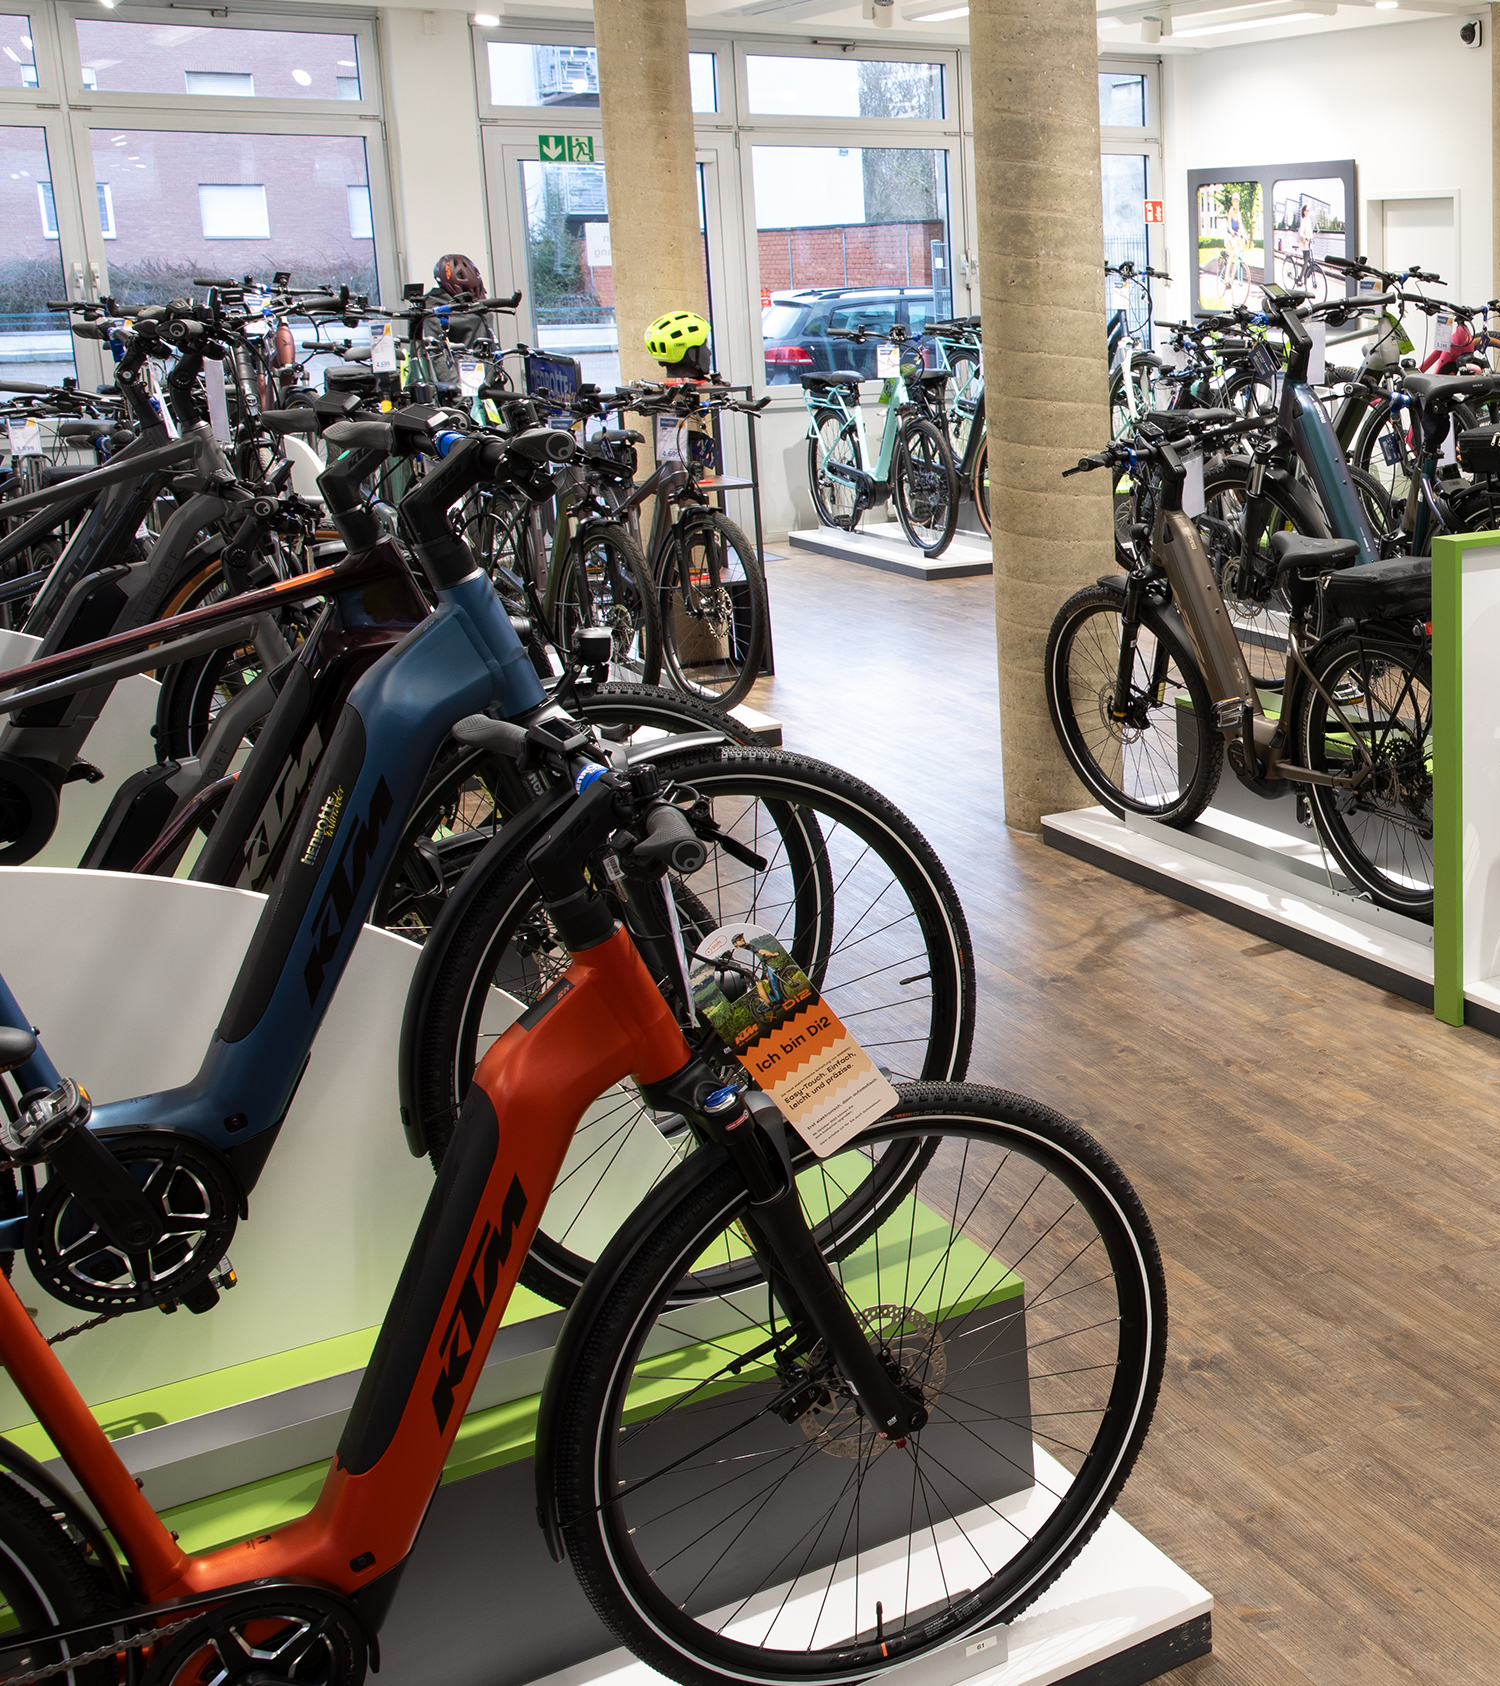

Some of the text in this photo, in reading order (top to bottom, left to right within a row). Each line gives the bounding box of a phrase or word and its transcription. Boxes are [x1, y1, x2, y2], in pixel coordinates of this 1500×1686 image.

[375, 360, 390, 368] 4.699
[16, 444, 34, 452] 3.899
[1184, 526, 1197, 550] macina
[134, 551, 182, 627] ALKHOFF
[236, 722, 324, 892] KTM
[302, 773, 394, 1007] KTM
[782, 988, 812, 1011] Di2
[734, 1023, 759, 1046] KTM
[755, 1051, 781, 1073] Ich
[780, 1034, 806, 1055] bin
[806, 1016, 832, 1037] Di2
[782, 1049, 857, 1104] Easy-Touch. Einfach,
[810, 1081, 825, 1094] und
[823, 1061, 855, 1085] präzise.
[431, 1173, 528, 1437] KTM
[975, 1642, 985, 1651] 61
